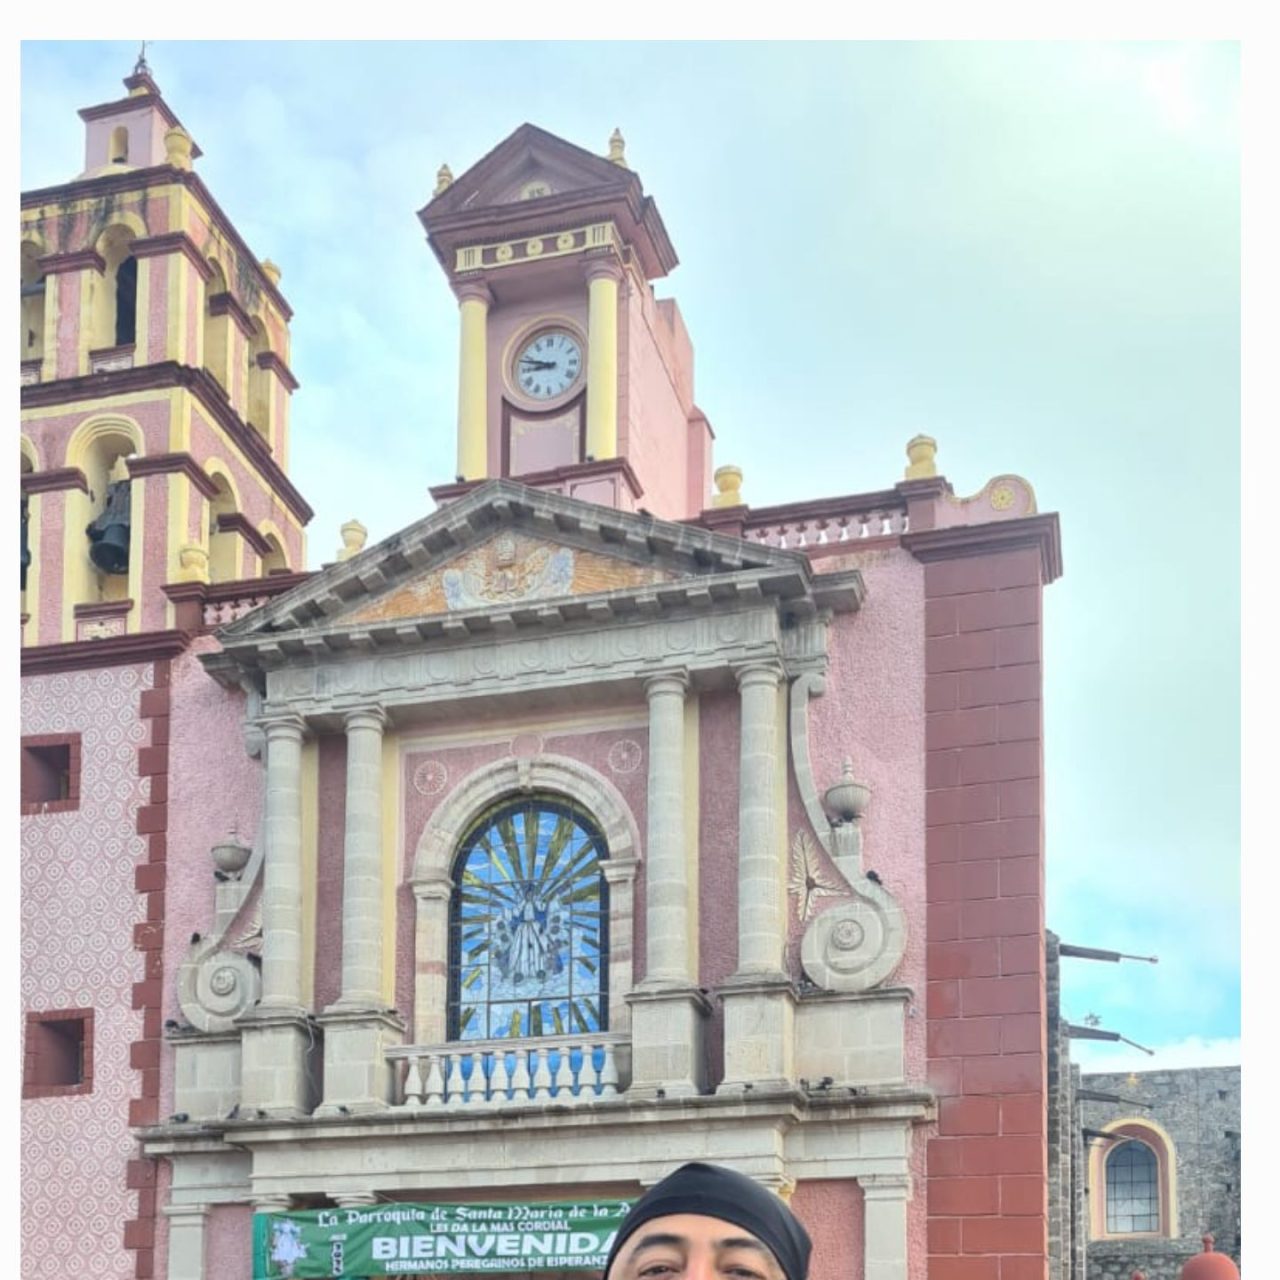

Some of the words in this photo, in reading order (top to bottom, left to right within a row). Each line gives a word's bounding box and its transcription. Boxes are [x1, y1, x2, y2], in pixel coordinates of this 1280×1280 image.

[318, 1211, 338, 1227] La
[344, 1208, 425, 1225] Parroquia
[431, 1207, 448, 1221] de
[455, 1206, 502, 1221] Santa
[570, 1203, 588, 1217] de
[451, 1223, 470, 1232] DA
[472, 1222, 488, 1232] LA
[490, 1221, 514, 1232] MAS
[517, 1220, 571, 1232] CORDIAL
[385, 1260, 448, 1272] HERMANOS
[451, 1257, 525, 1270] PEREGRINOS
[528, 1257, 545, 1267] DE
[547, 1255, 608, 1266] ESPERANZ
